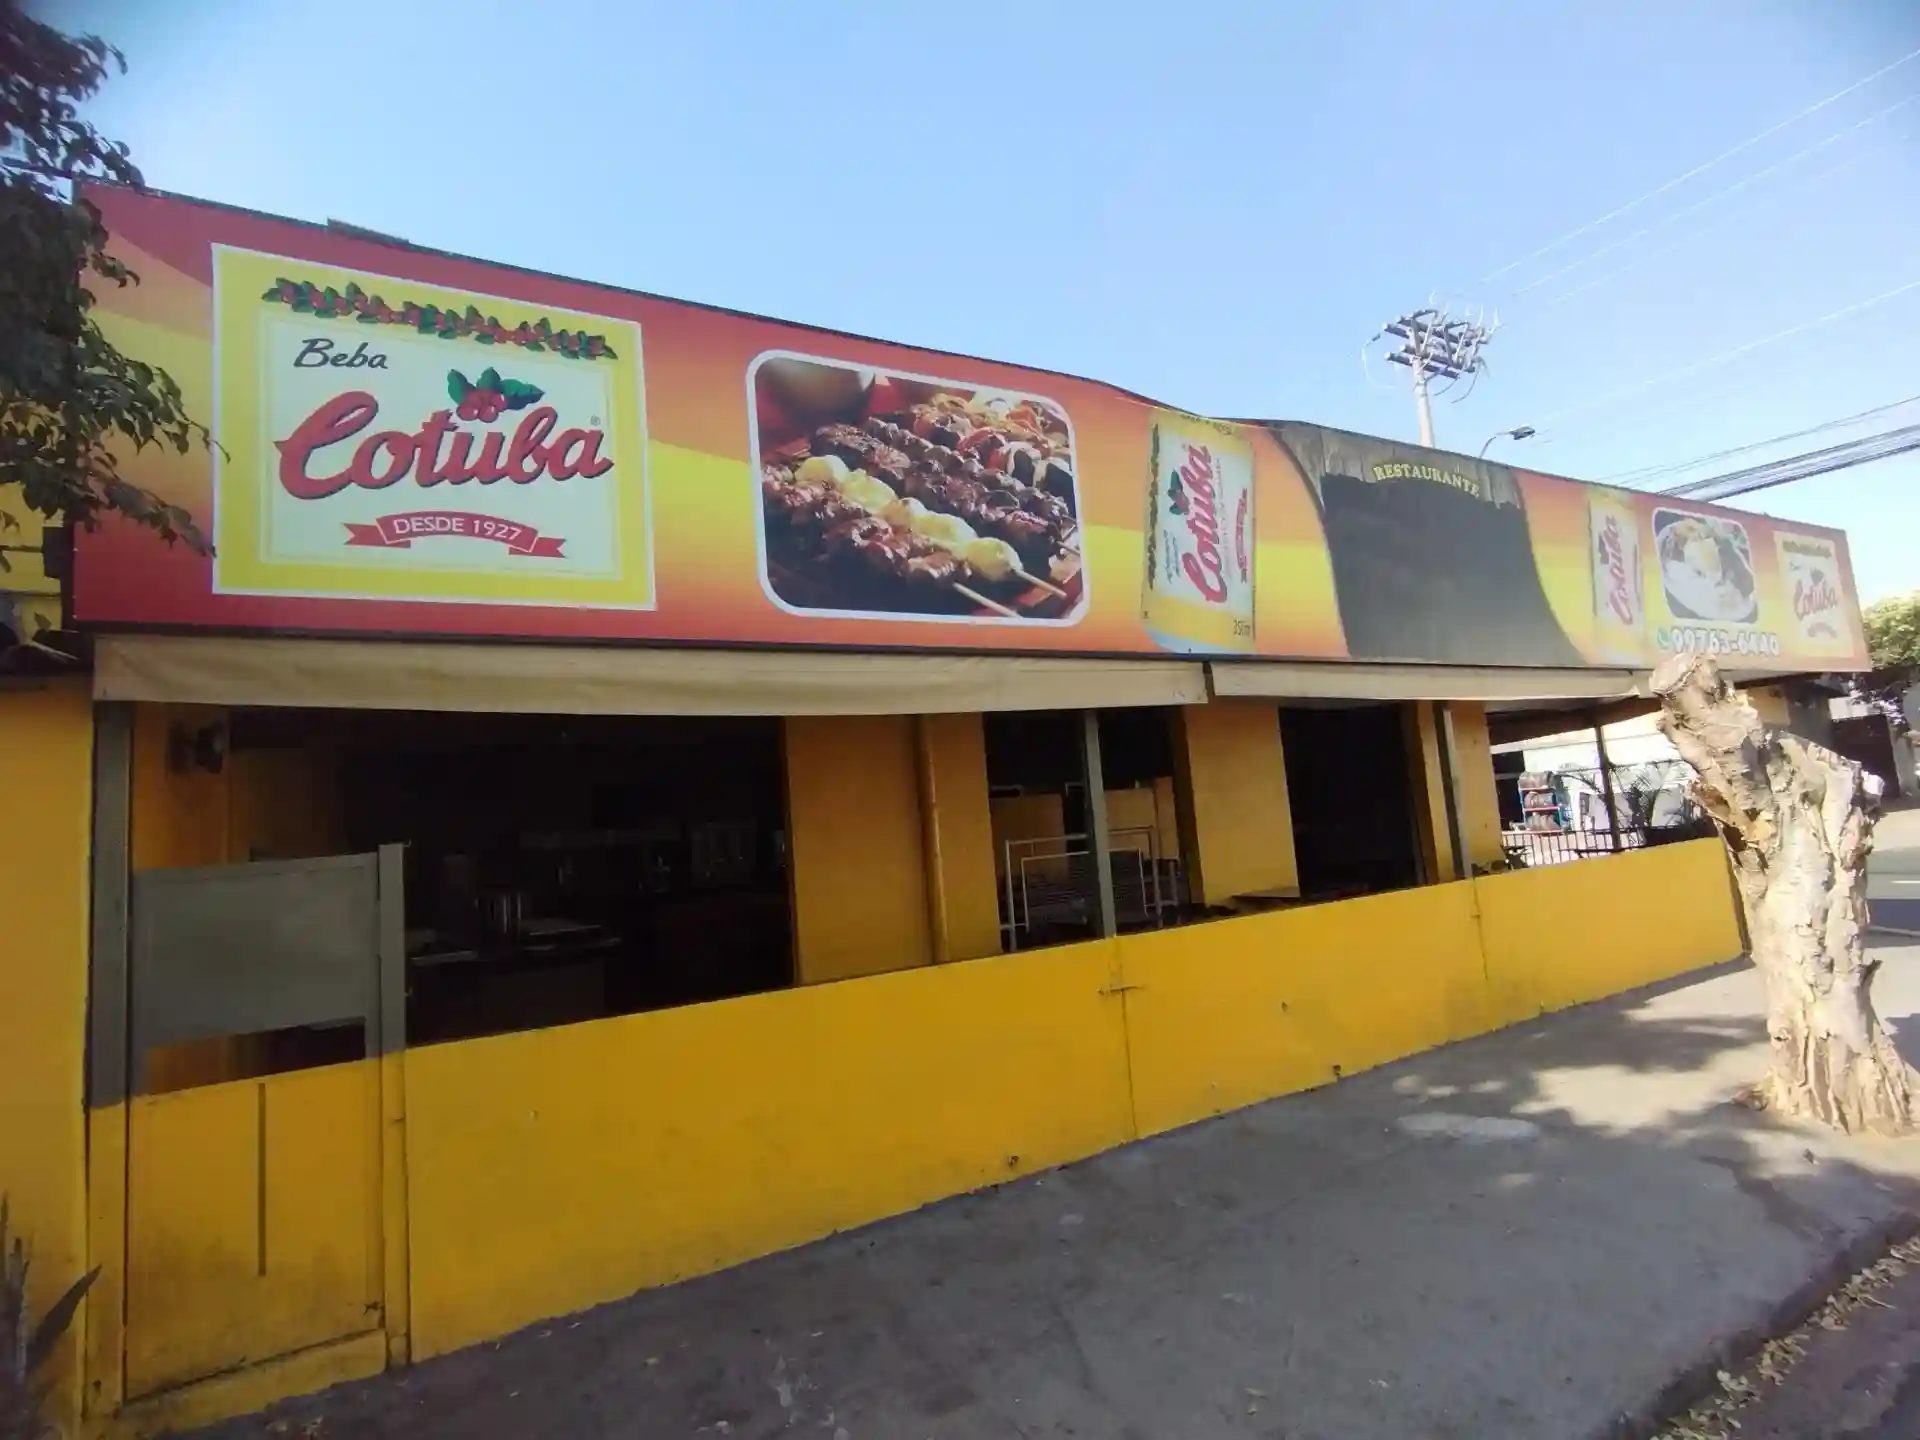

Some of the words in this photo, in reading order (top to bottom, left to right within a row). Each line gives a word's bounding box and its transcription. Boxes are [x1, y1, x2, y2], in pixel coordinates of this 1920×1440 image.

[293, 338, 388, 370] Beba
[273, 390, 614, 500] Cotuba
[1373, 462, 1481, 499] RESTAURANTE
[395, 516, 465, 535] DESDE
[472, 518, 523, 541] 1927
[1181, 445, 1228, 604] Cotuba
